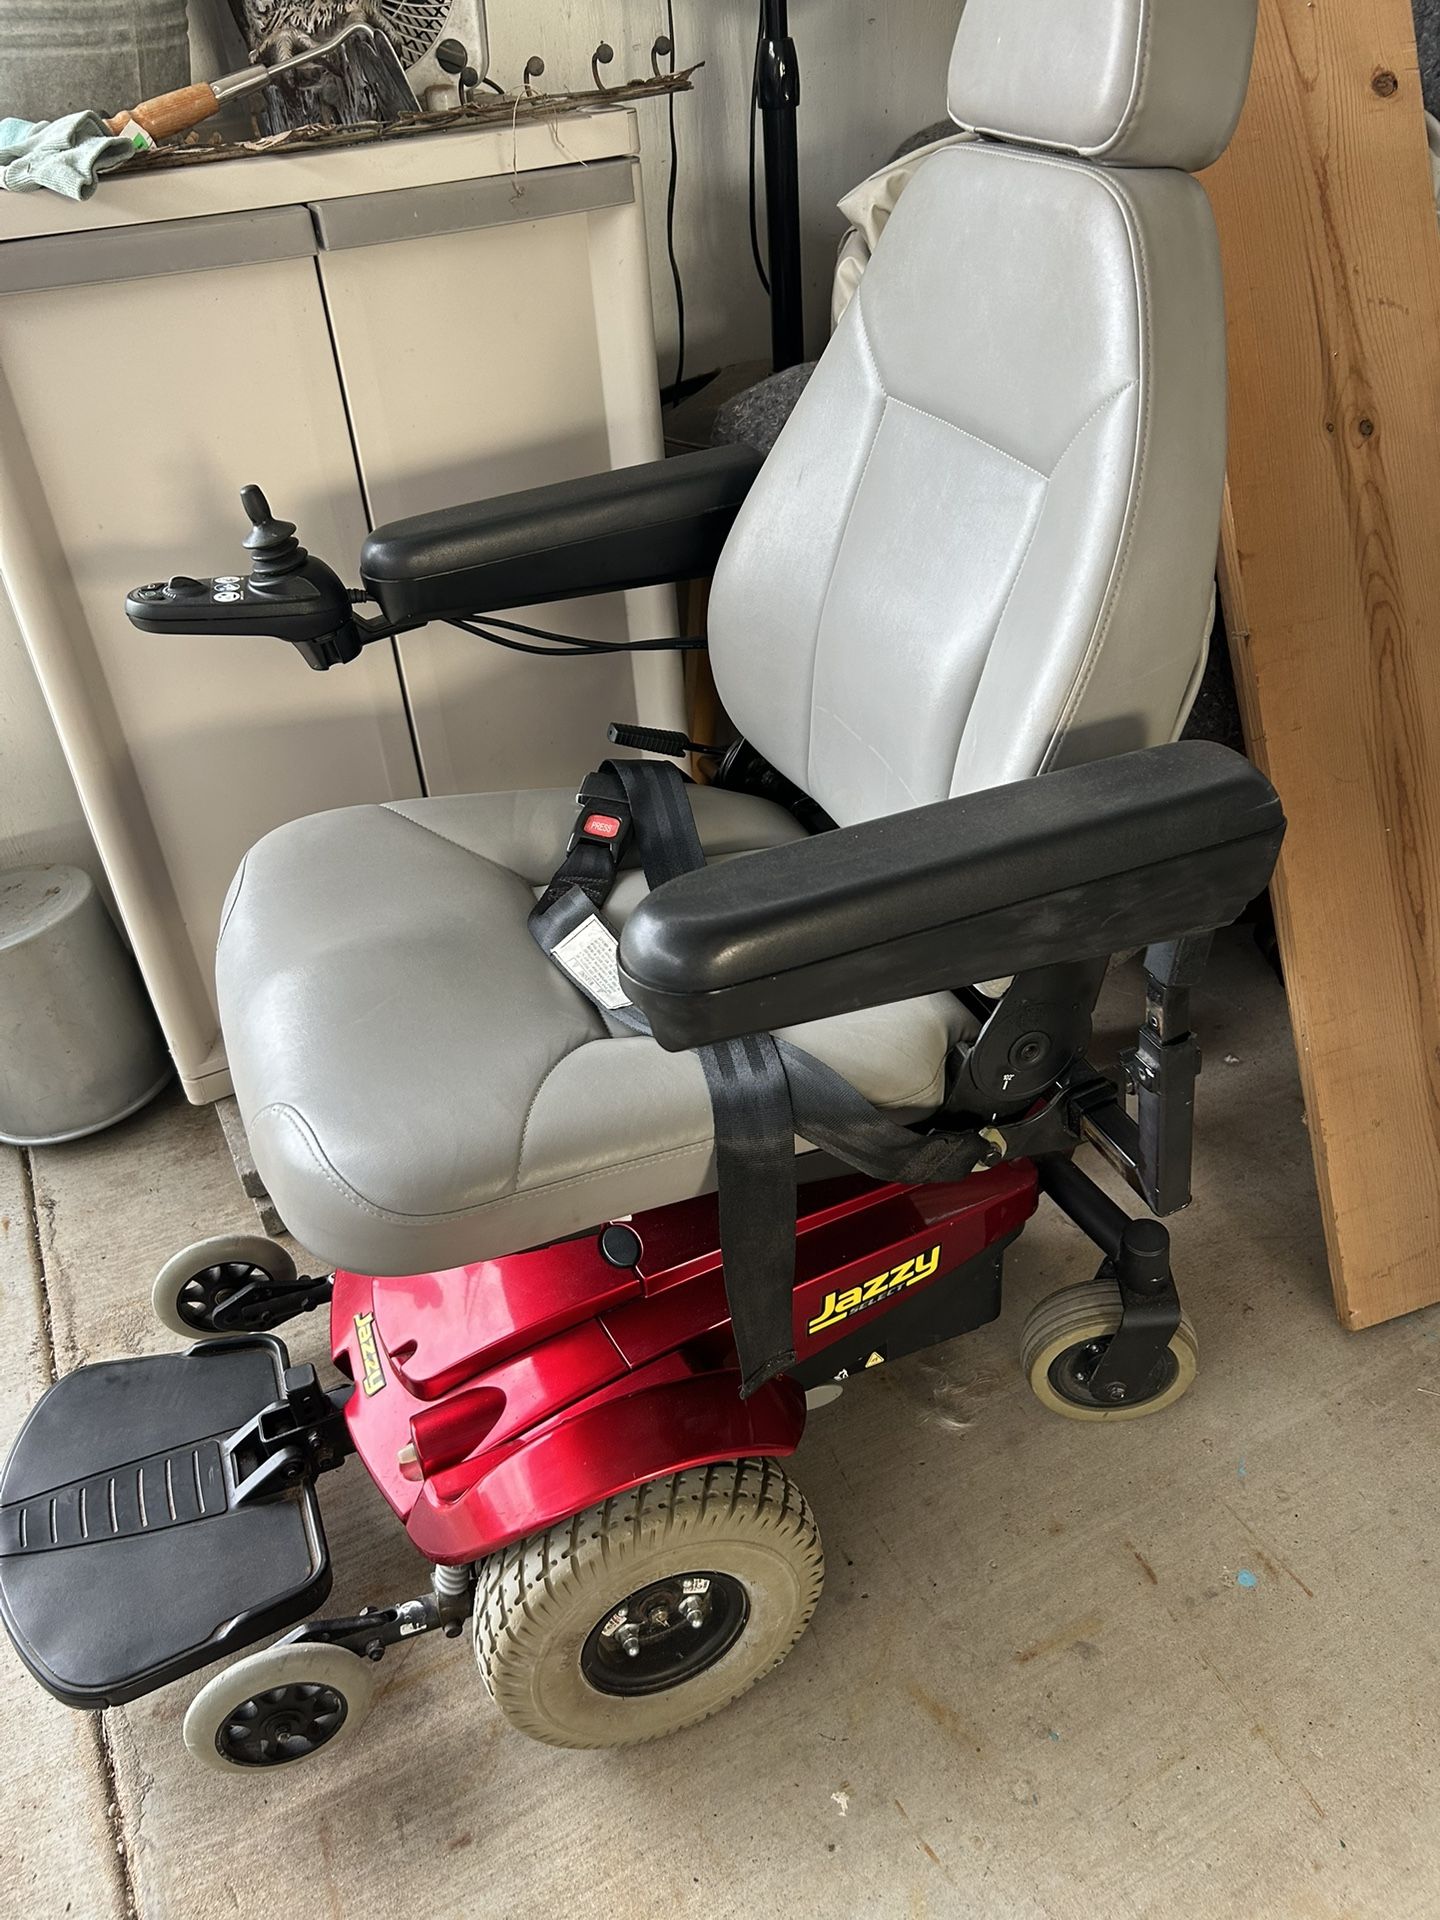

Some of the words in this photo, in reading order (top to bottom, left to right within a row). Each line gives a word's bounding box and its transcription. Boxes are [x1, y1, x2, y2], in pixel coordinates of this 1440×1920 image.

[590, 821, 613, 833] PRESS
[809, 1245, 941, 1334] Jazzy
[848, 1282, 906, 1315] SELECT
